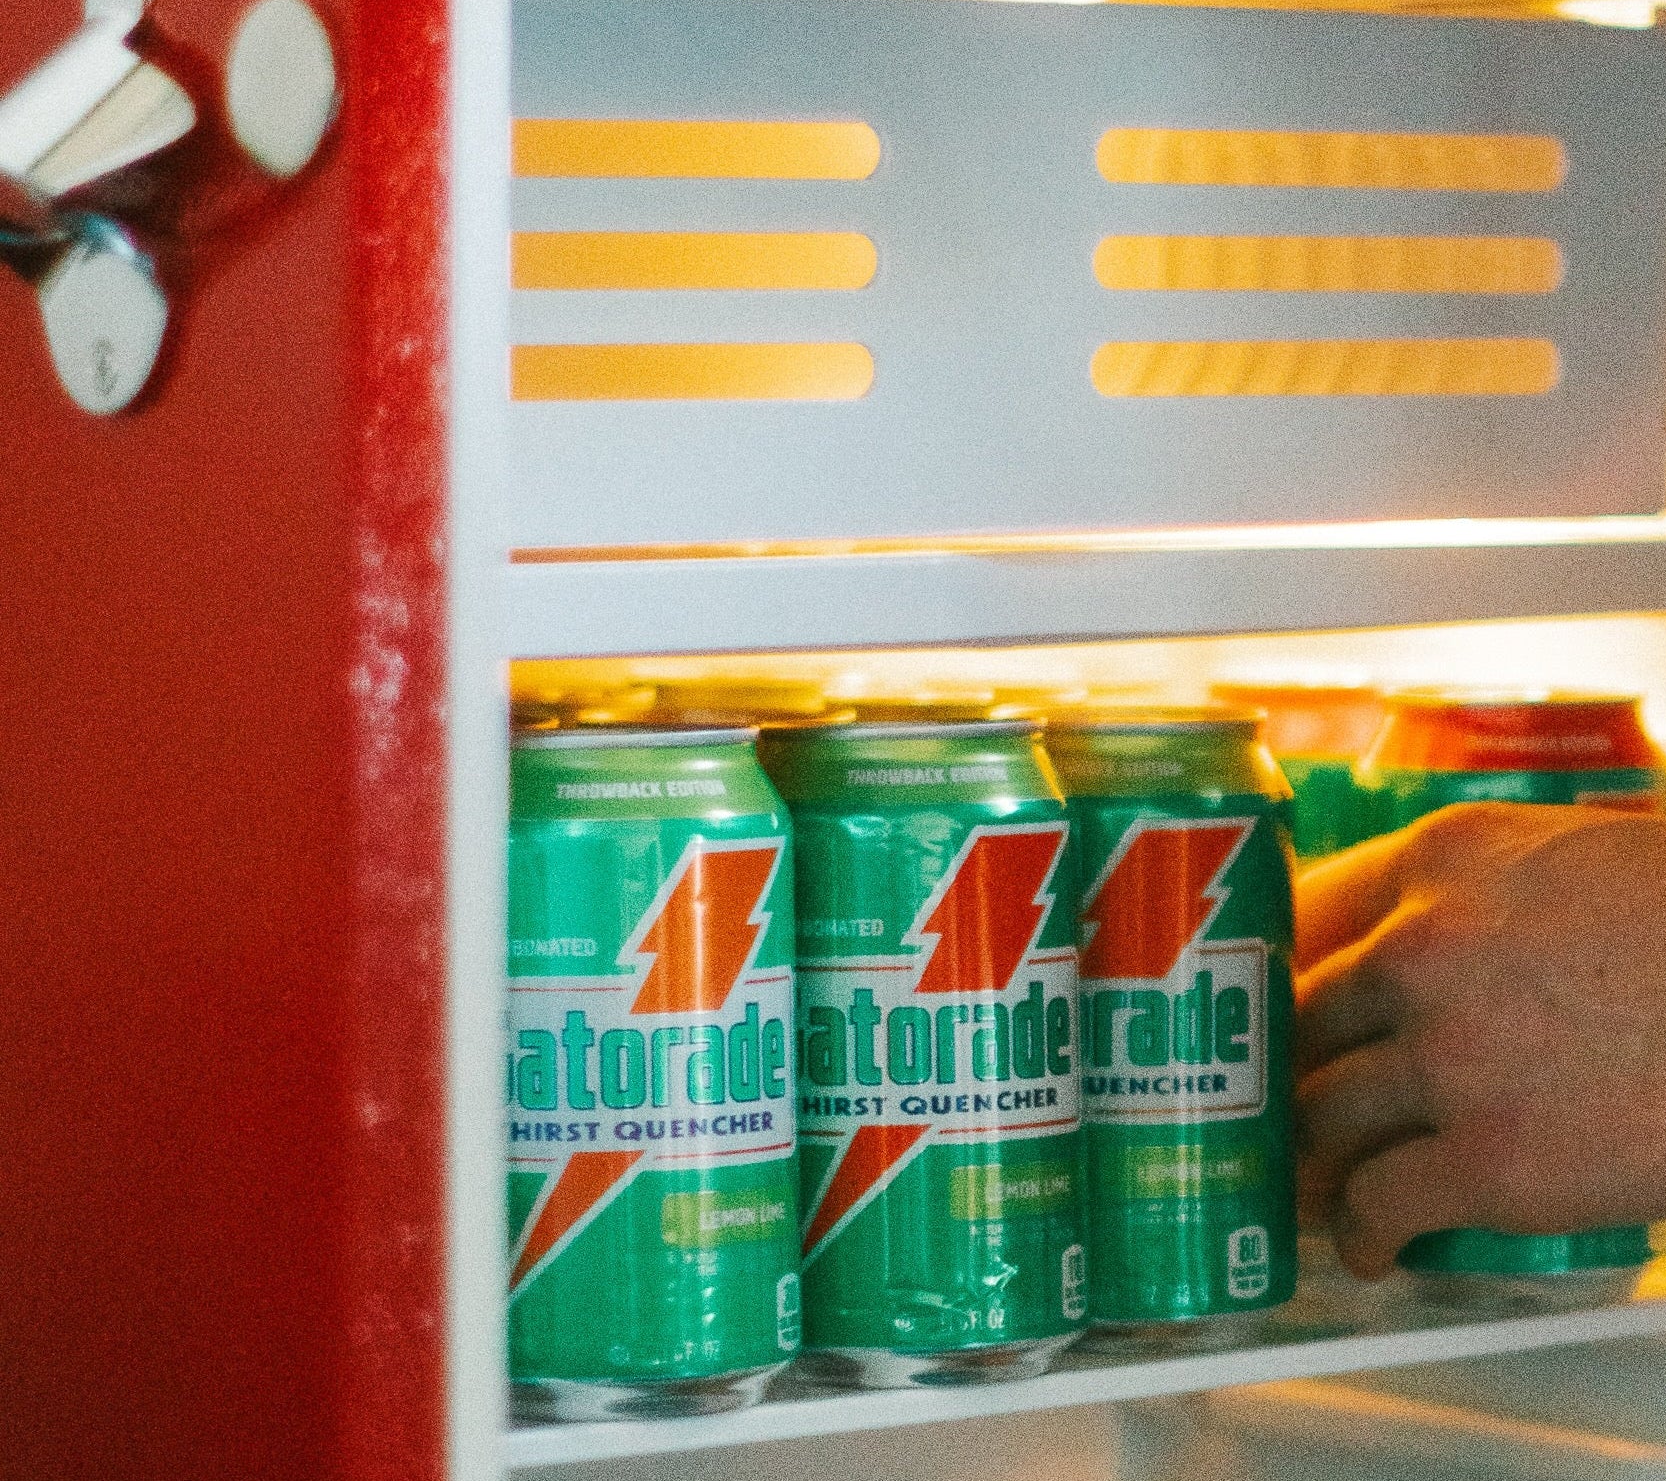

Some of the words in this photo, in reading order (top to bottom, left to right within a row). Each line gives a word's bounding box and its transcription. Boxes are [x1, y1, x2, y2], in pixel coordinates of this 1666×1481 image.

[511, 937, 598, 957] BONATED
[798, 980, 1071, 1088] atorade
[506, 1001, 786, 1112] atorade
[1082, 1073, 1228, 1096] UENCHER
[801, 1096, 886, 1117] HIRST
[899, 1087, 1058, 1116] QUENCHER
[510, 1120, 600, 1143] HIRST
[613, 1110, 774, 1143] QUENCHER
